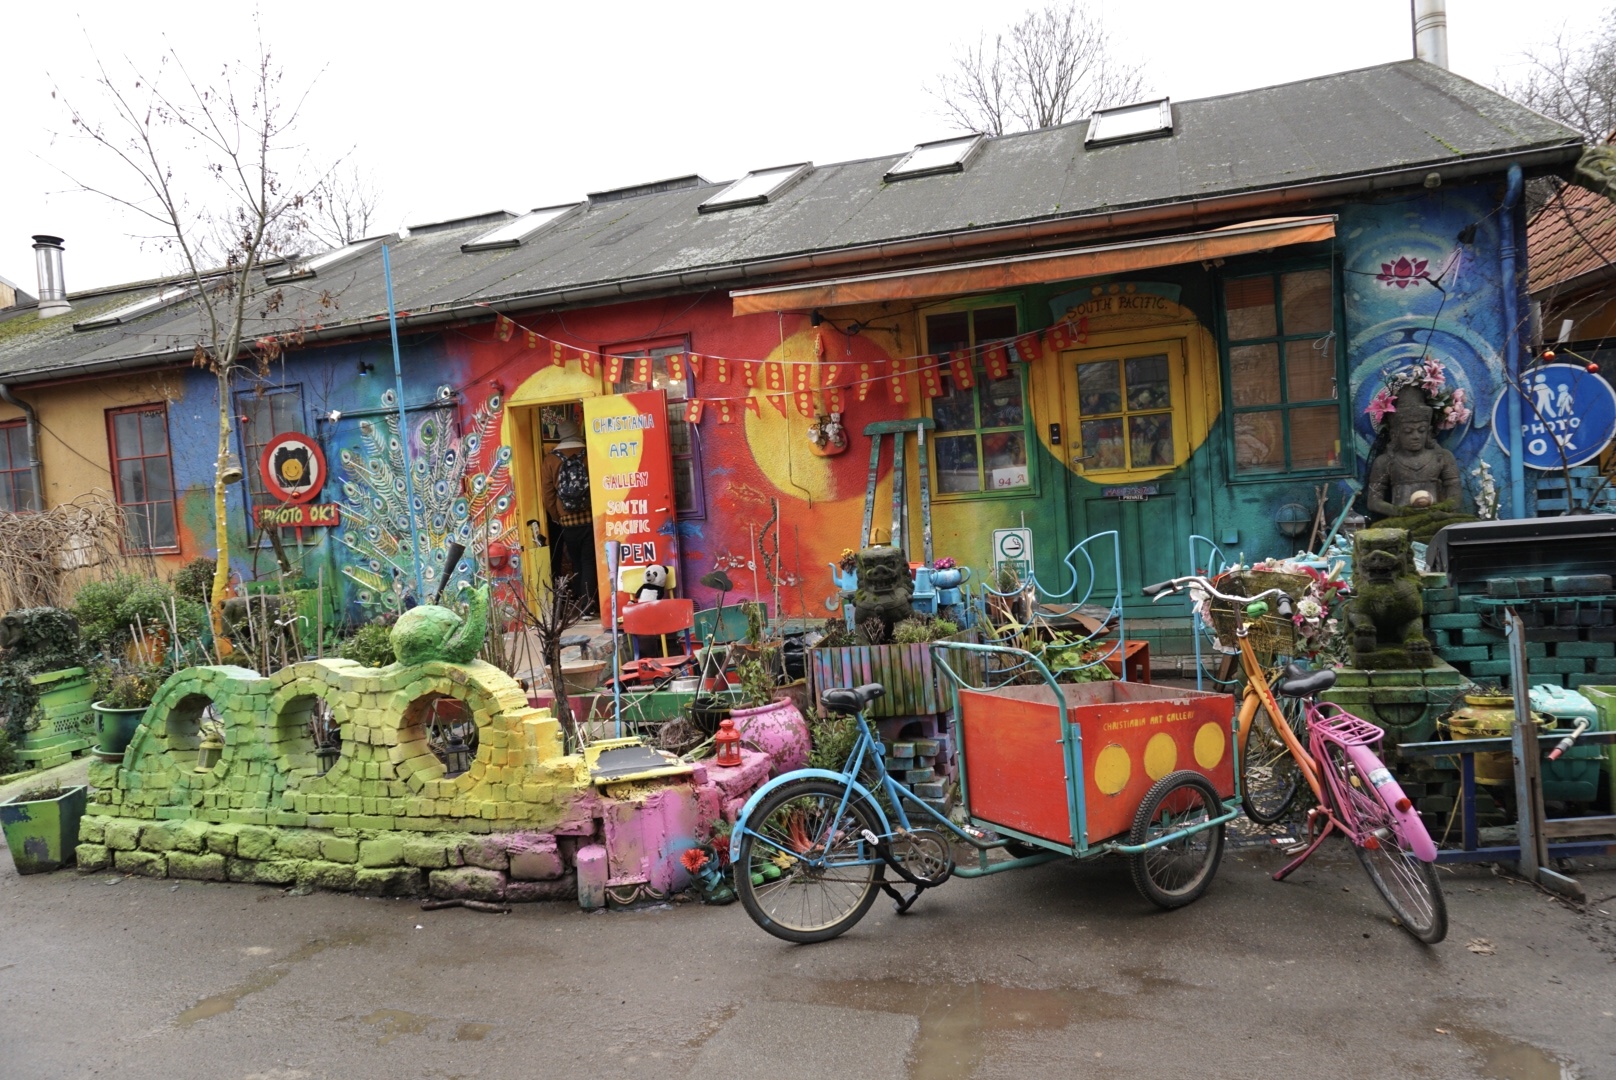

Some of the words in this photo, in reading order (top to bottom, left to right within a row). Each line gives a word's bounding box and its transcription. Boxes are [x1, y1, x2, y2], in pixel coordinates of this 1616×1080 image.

[1066, 298, 1112, 319] SOUTH
[1521, 417, 1580, 437] PHOTO
[609, 441, 638, 458] ART
[602, 471, 648, 490] GALLERY
[998, 478, 1011, 487] 94
[1015, 473, 1026, 484] A
[606, 499, 648, 515] SOUTH
[605, 519, 650, 536] PACIFIC
[617, 541, 656, 563] PEN
[1149, 715, 1163, 725] ART
